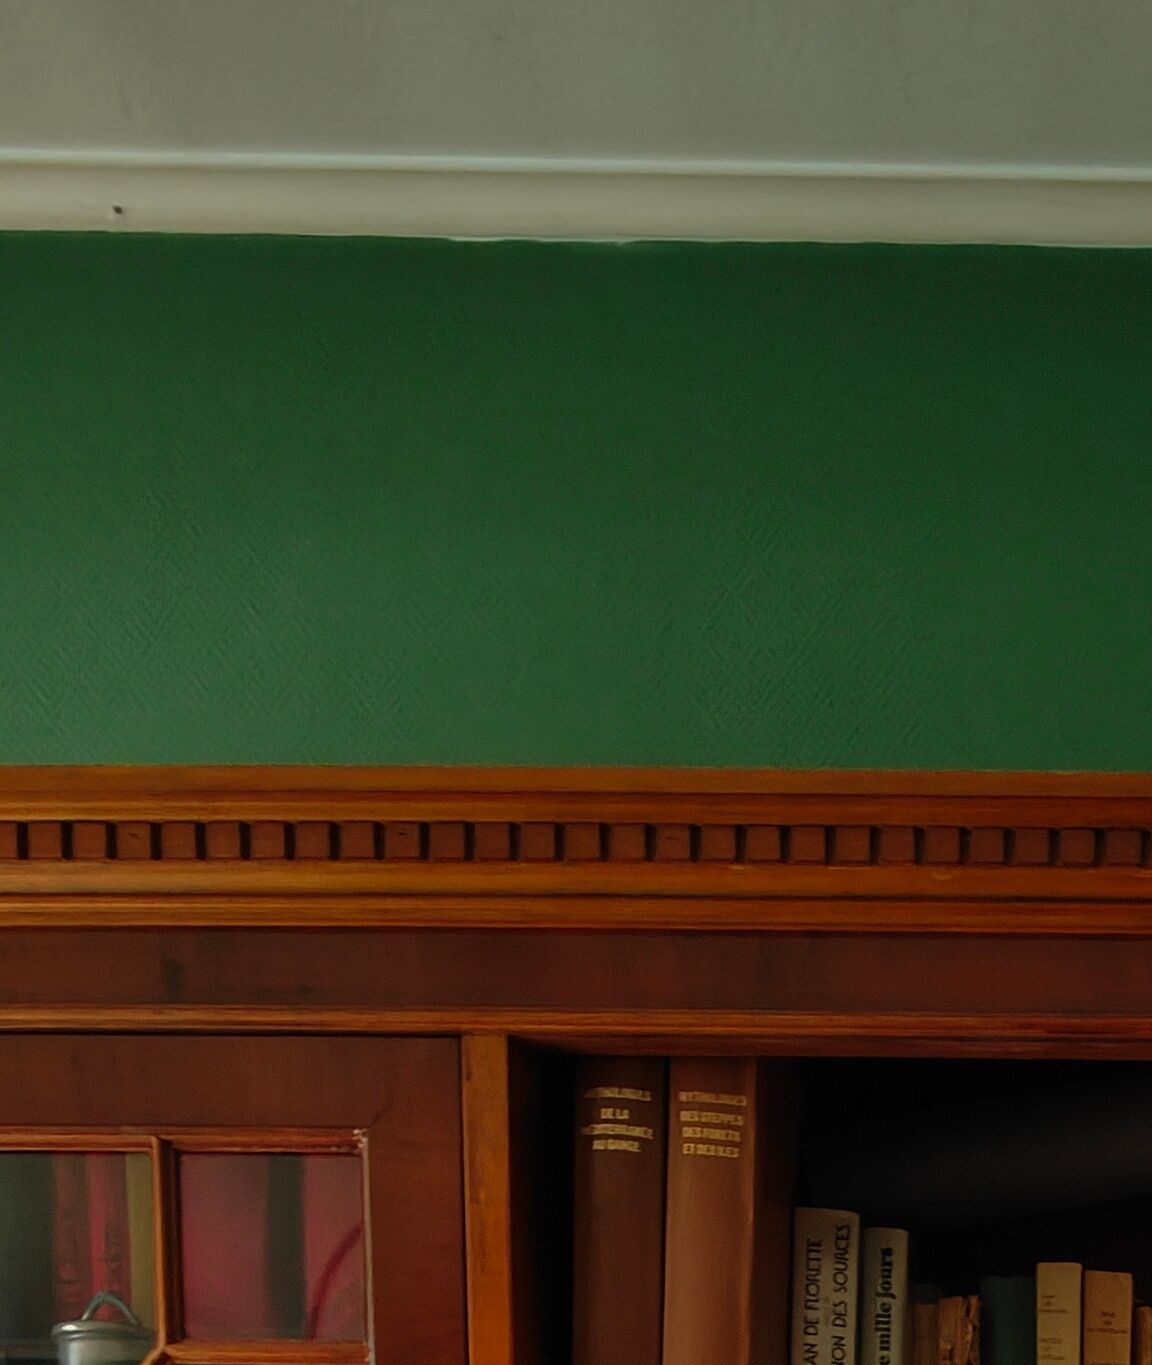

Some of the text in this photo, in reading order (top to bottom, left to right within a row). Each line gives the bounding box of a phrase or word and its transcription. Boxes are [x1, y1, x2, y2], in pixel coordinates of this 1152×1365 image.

[804, 1237, 823, 1311] FLORETTE
[832, 1223, 850, 1293] SOURCES
[875, 1247, 897, 1300] jours
[804, 1315, 820, 1336] DE
[832, 1300, 849, 1328] DES
[875, 1300, 892, 1352] mille
